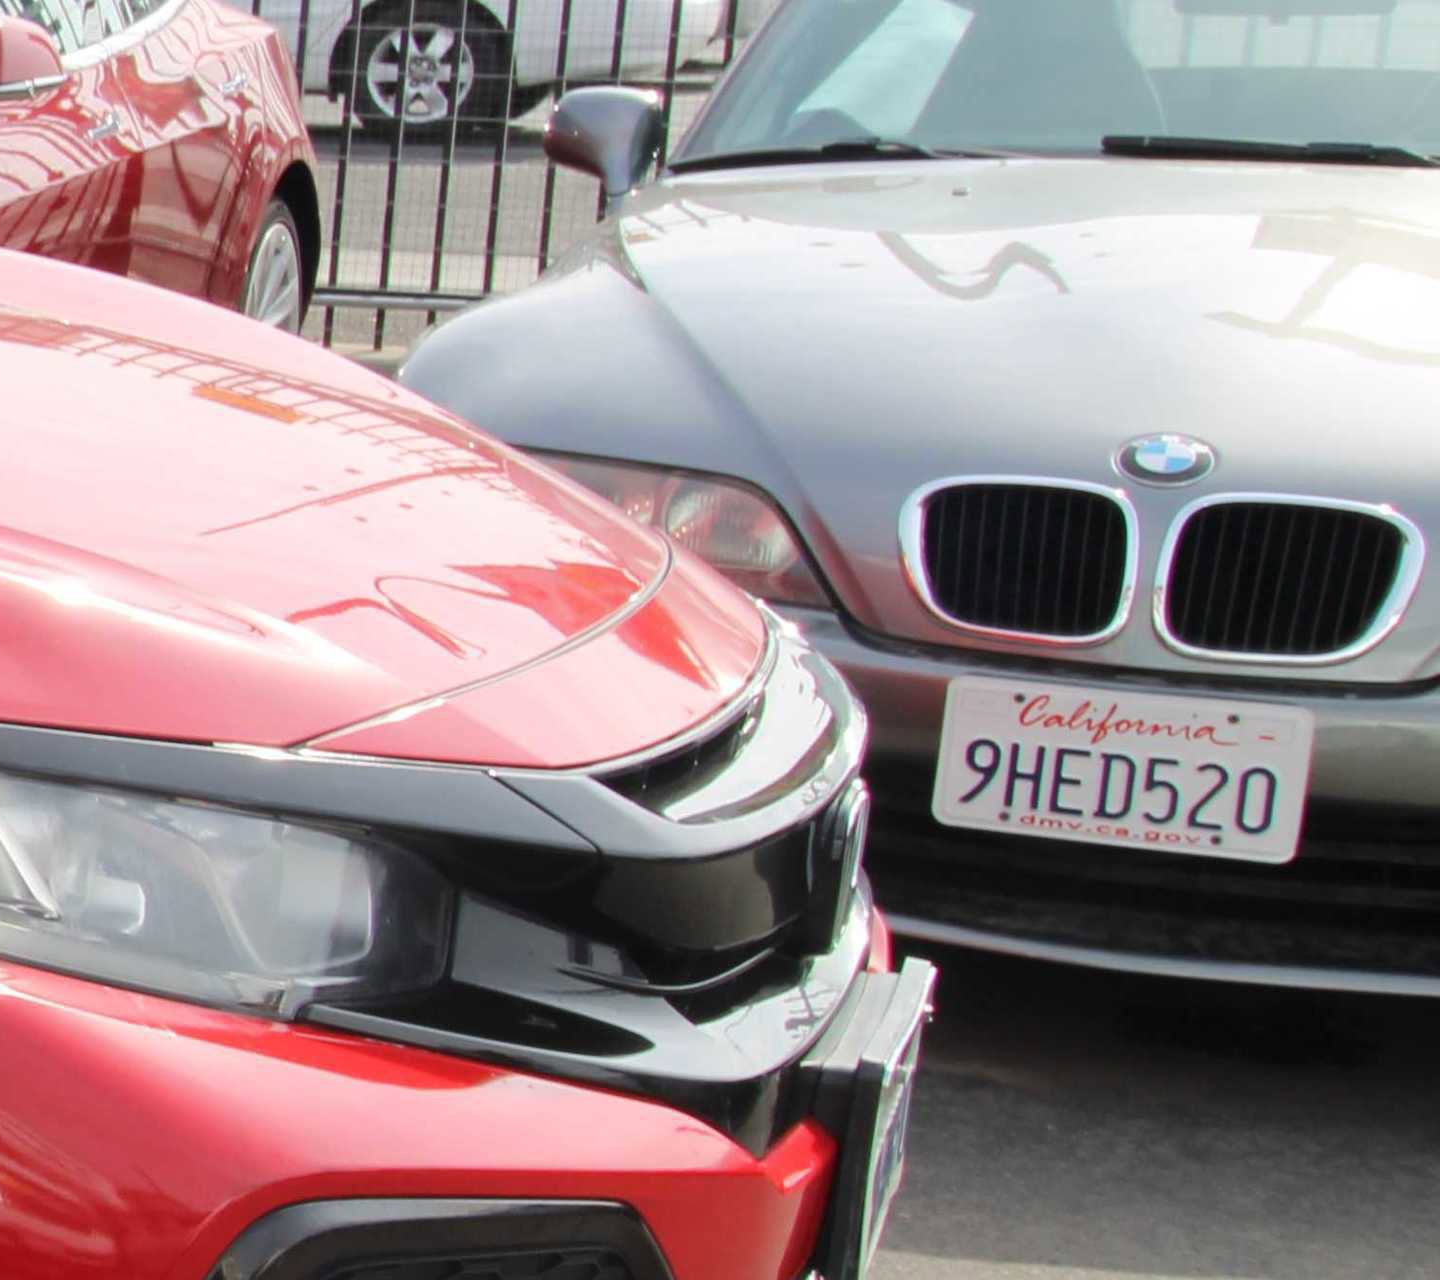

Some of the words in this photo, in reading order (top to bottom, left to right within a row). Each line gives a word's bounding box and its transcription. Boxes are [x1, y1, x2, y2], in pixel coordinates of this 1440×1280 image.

[1017, 694, 1240, 749] California
[958, 737, 1279, 836] 9HED520
[1018, 812, 1203, 848] dmv.ca.gov
